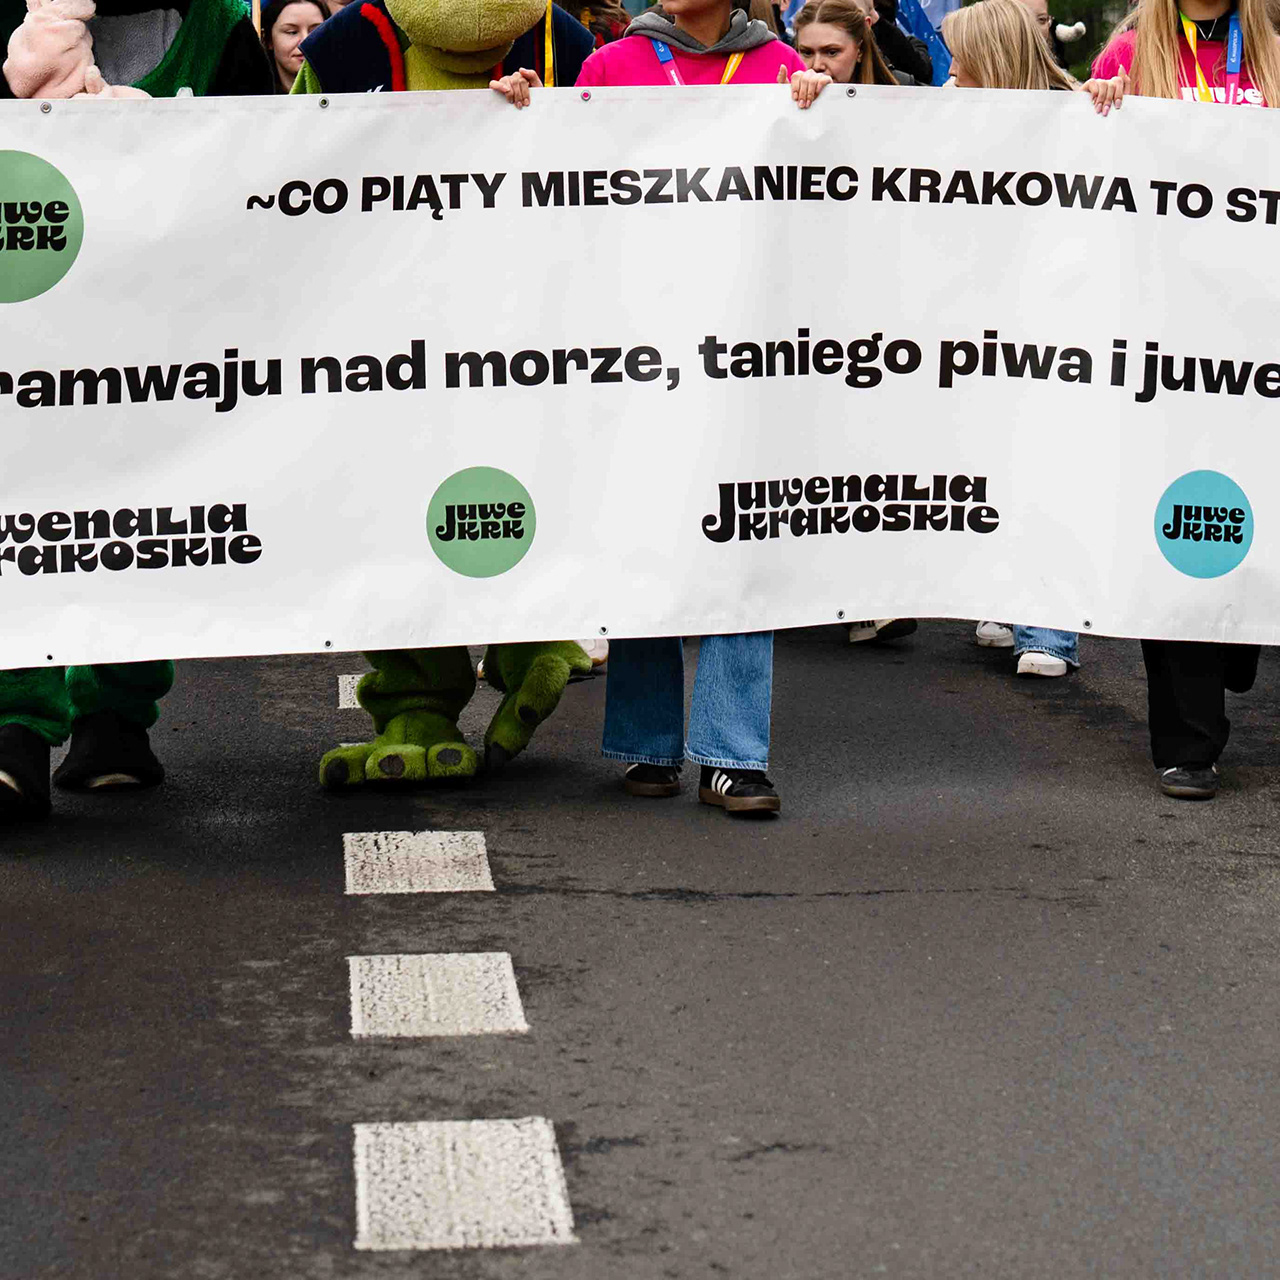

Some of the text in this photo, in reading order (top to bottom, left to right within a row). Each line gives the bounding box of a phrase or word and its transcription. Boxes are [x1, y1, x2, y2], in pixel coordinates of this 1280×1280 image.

[362, 173, 506, 220] PIĄTY
[522, 166, 858, 207] MIESZKANIEC
[872, 167, 1137, 212] KRAKOWA
[1150, 181, 1213, 218] TO
[301, 340, 426, 393] nad
[446, 346, 679, 390] morze,
[699, 328, 921, 388] taniego
[939, 330, 1092, 388] piwa
[1111, 339, 1127, 386] i
